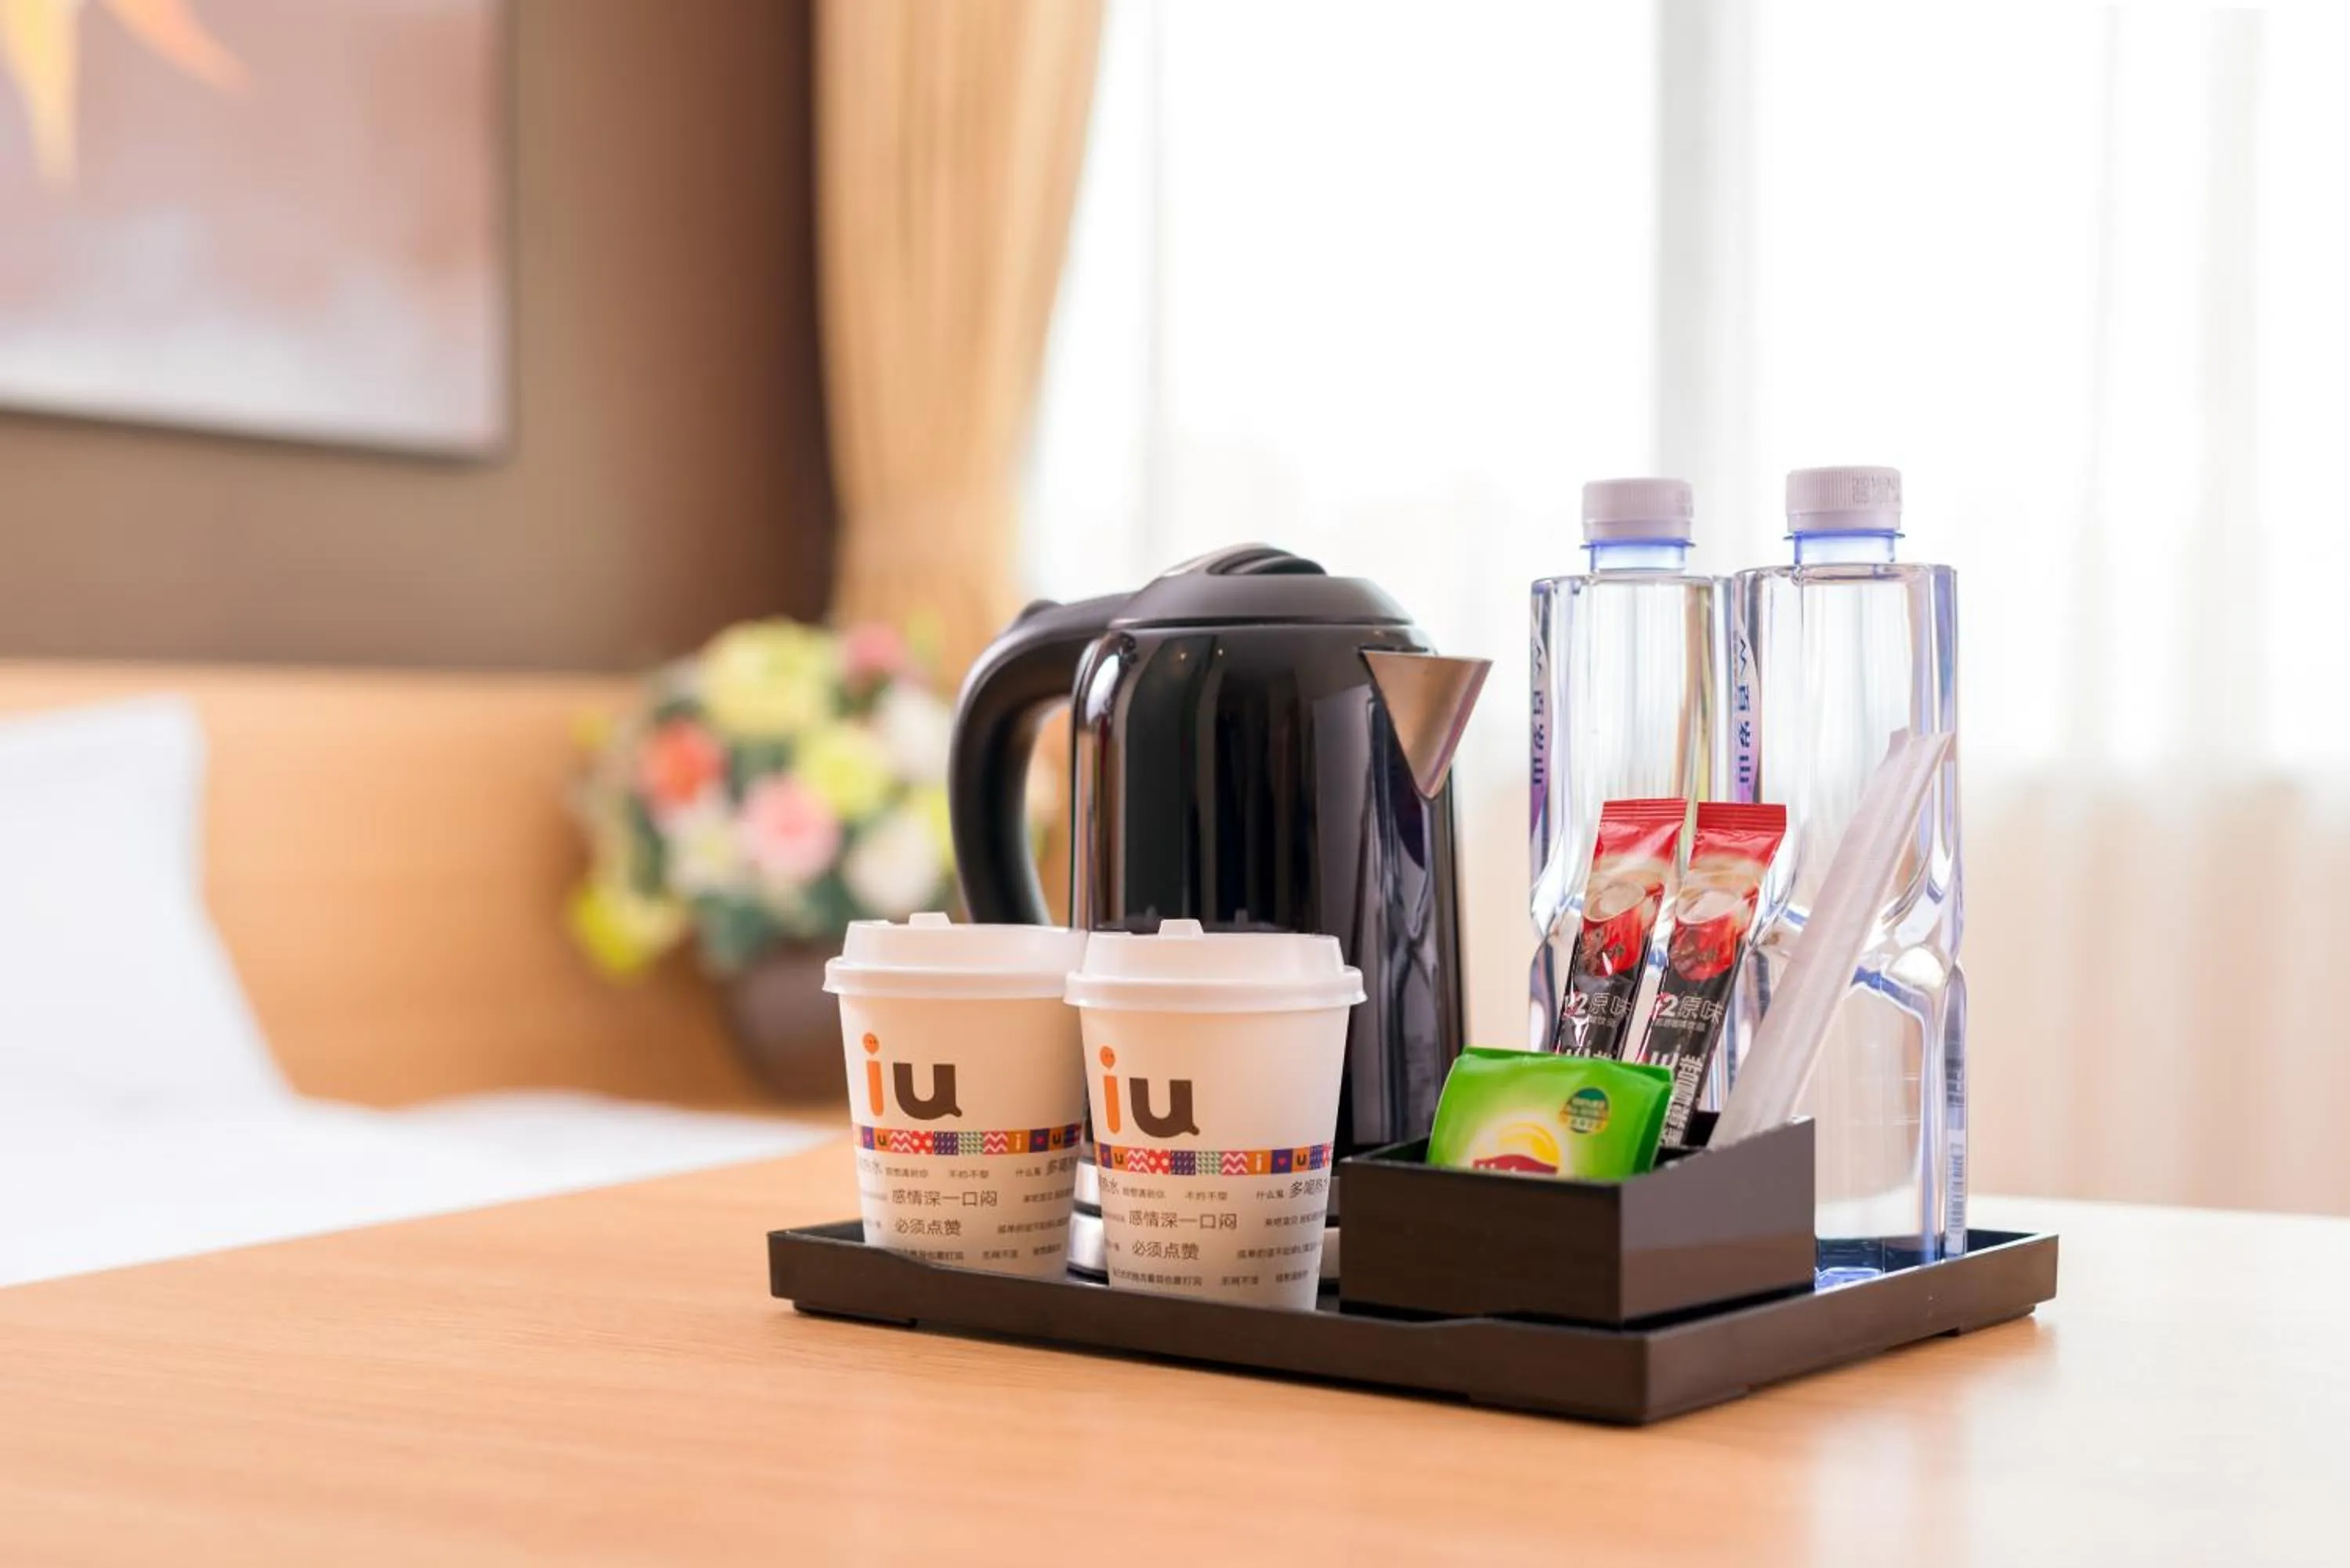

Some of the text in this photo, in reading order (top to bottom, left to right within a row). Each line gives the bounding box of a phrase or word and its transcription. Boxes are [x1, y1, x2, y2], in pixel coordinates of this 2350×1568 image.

[862, 1032, 963, 1121] iu
[1100, 1046, 1200, 1138] iu
[892, 1190, 997, 1206] 感情深一口闷
[894, 1217, 962, 1237] 必须点赞
[1129, 1210, 1237, 1230] 感情深一口闷
[1132, 1241, 1199, 1260] 必须点赞
